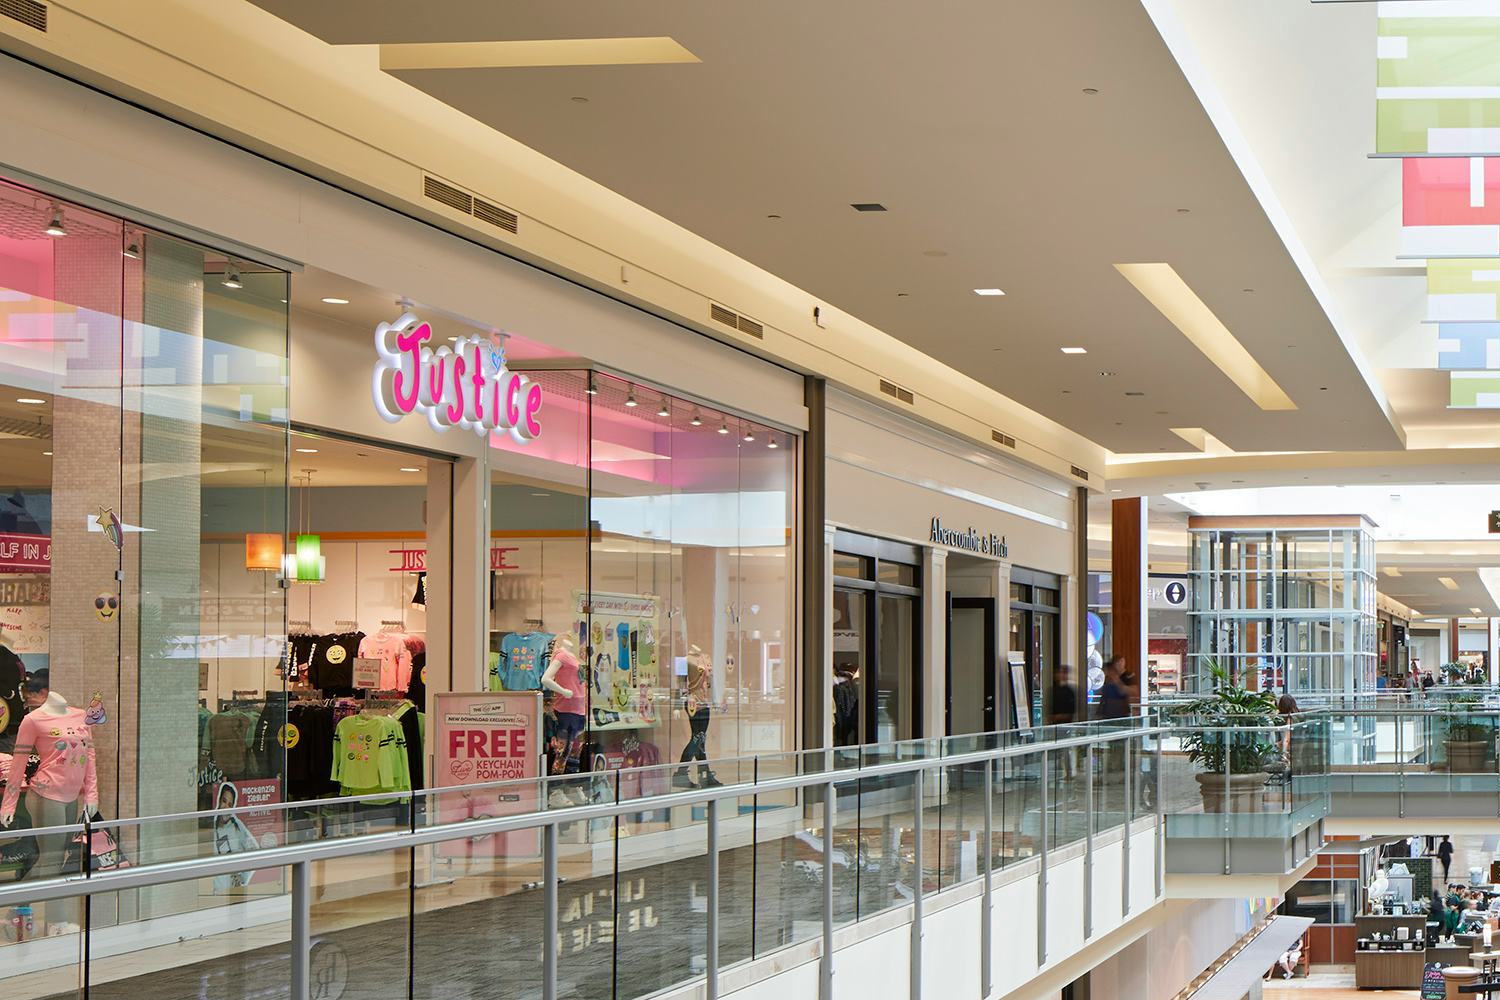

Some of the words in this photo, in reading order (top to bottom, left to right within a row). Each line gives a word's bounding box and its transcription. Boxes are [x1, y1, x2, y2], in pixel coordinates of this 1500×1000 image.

[393, 322, 541, 437] Justice
[930, 517, 980, 552] Abercrombie
[990, 533, 1008, 557] Fitch
[449, 729, 526, 758] FREE
[476, 760, 524, 769] KEYCHAIN
[476, 770, 524, 779] POM-POM
